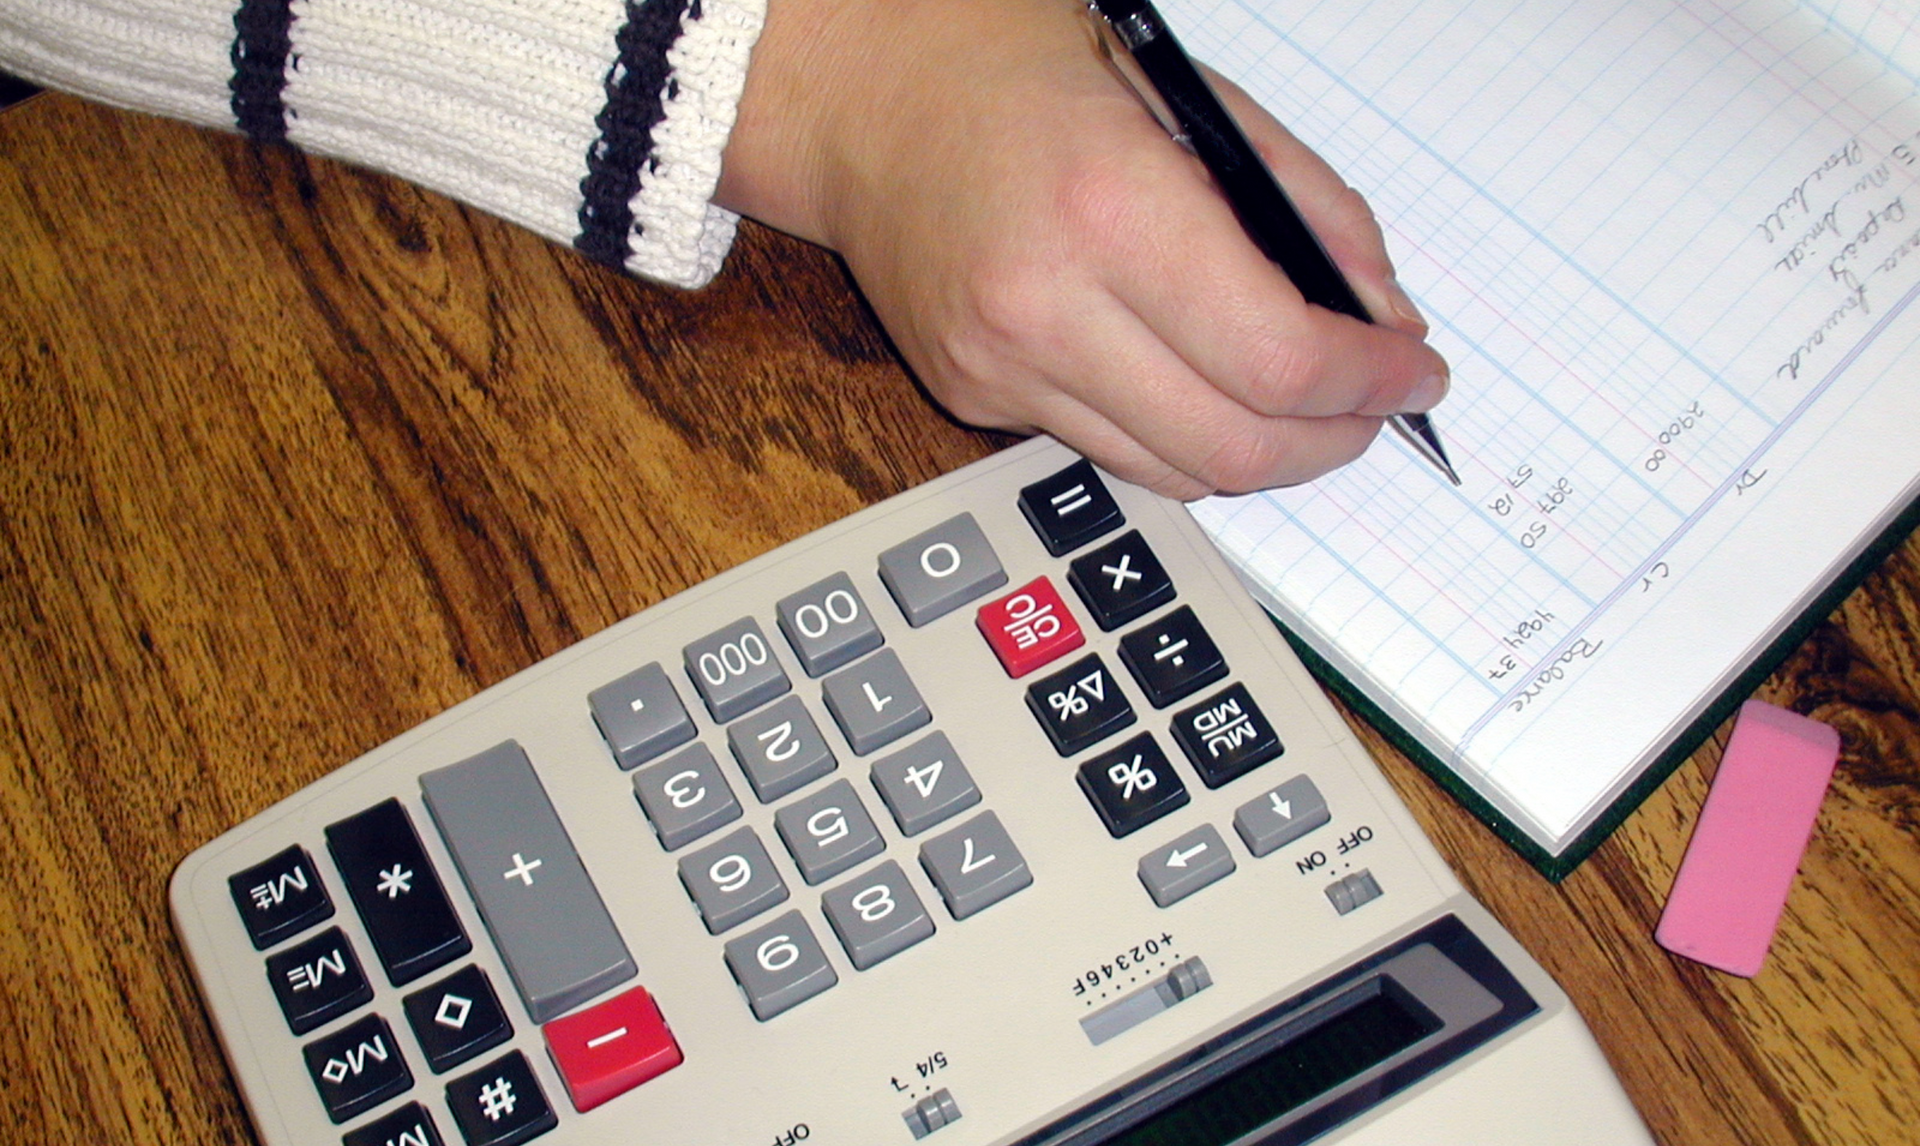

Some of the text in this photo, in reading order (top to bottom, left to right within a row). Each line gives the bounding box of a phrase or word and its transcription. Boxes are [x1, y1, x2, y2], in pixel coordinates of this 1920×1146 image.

[1829, 196, 1904, 282] Deposit
[1645, 400, 1704, 472] 2900 00
[1736, 469, 1768, 496] Dr
[1488, 496, 1514, 517] 12
[1520, 476, 1574, 549] 297 50
[1641, 561, 1670, 592] Cr
[795, 590, 859, 638] 00
[1011, 614, 1061, 650] CE
[699, 632, 768, 686] 000
[1489, 608, 1556, 681] 4924 37
[1508, 636, 1604, 713] Balance
[862, 681, 893, 713] 1
[1193, 698, 1241, 731] MD
[757, 721, 800, 762] 2
[1208, 720, 1258, 758] MU
[663, 770, 706, 809] 3
[904, 760, 945, 798] 4
[806, 807, 850, 847] 5
[961, 838, 996, 874] 7
[1296, 825, 1374, 876] OFF ON
[709, 854, 752, 892] 6
[852, 884, 896, 922] 8
[756, 934, 799, 972] 9
[916, 1050, 949, 1079] 5/4
